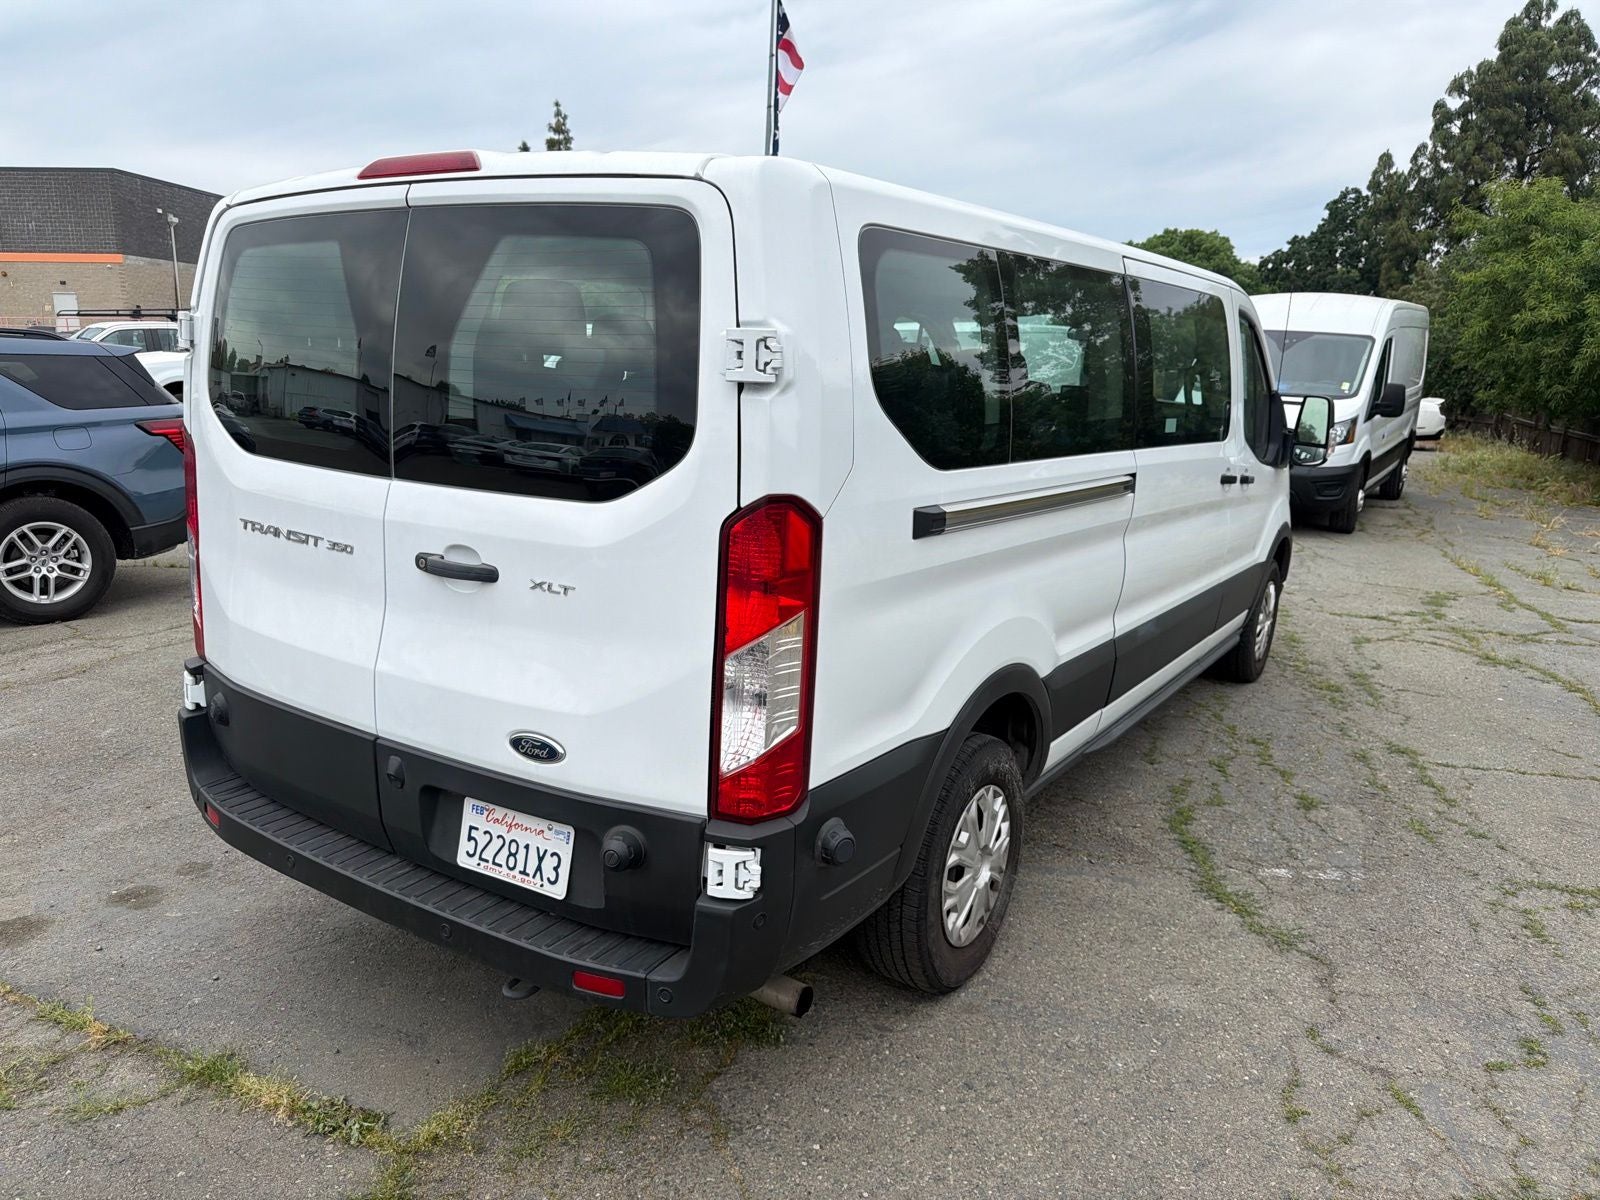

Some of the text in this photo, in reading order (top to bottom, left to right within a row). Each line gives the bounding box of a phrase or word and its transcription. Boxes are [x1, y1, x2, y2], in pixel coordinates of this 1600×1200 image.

[239, 518, 354, 555] TRANSIT 350
[529, 580, 576, 596] XLT
[519, 739, 549, 758] Ford
[471, 804, 485, 816] FEB
[485, 808, 551, 840] California
[465, 825, 561, 885] 52281X3
[483, 864, 538, 886] dmv.ca.gov
